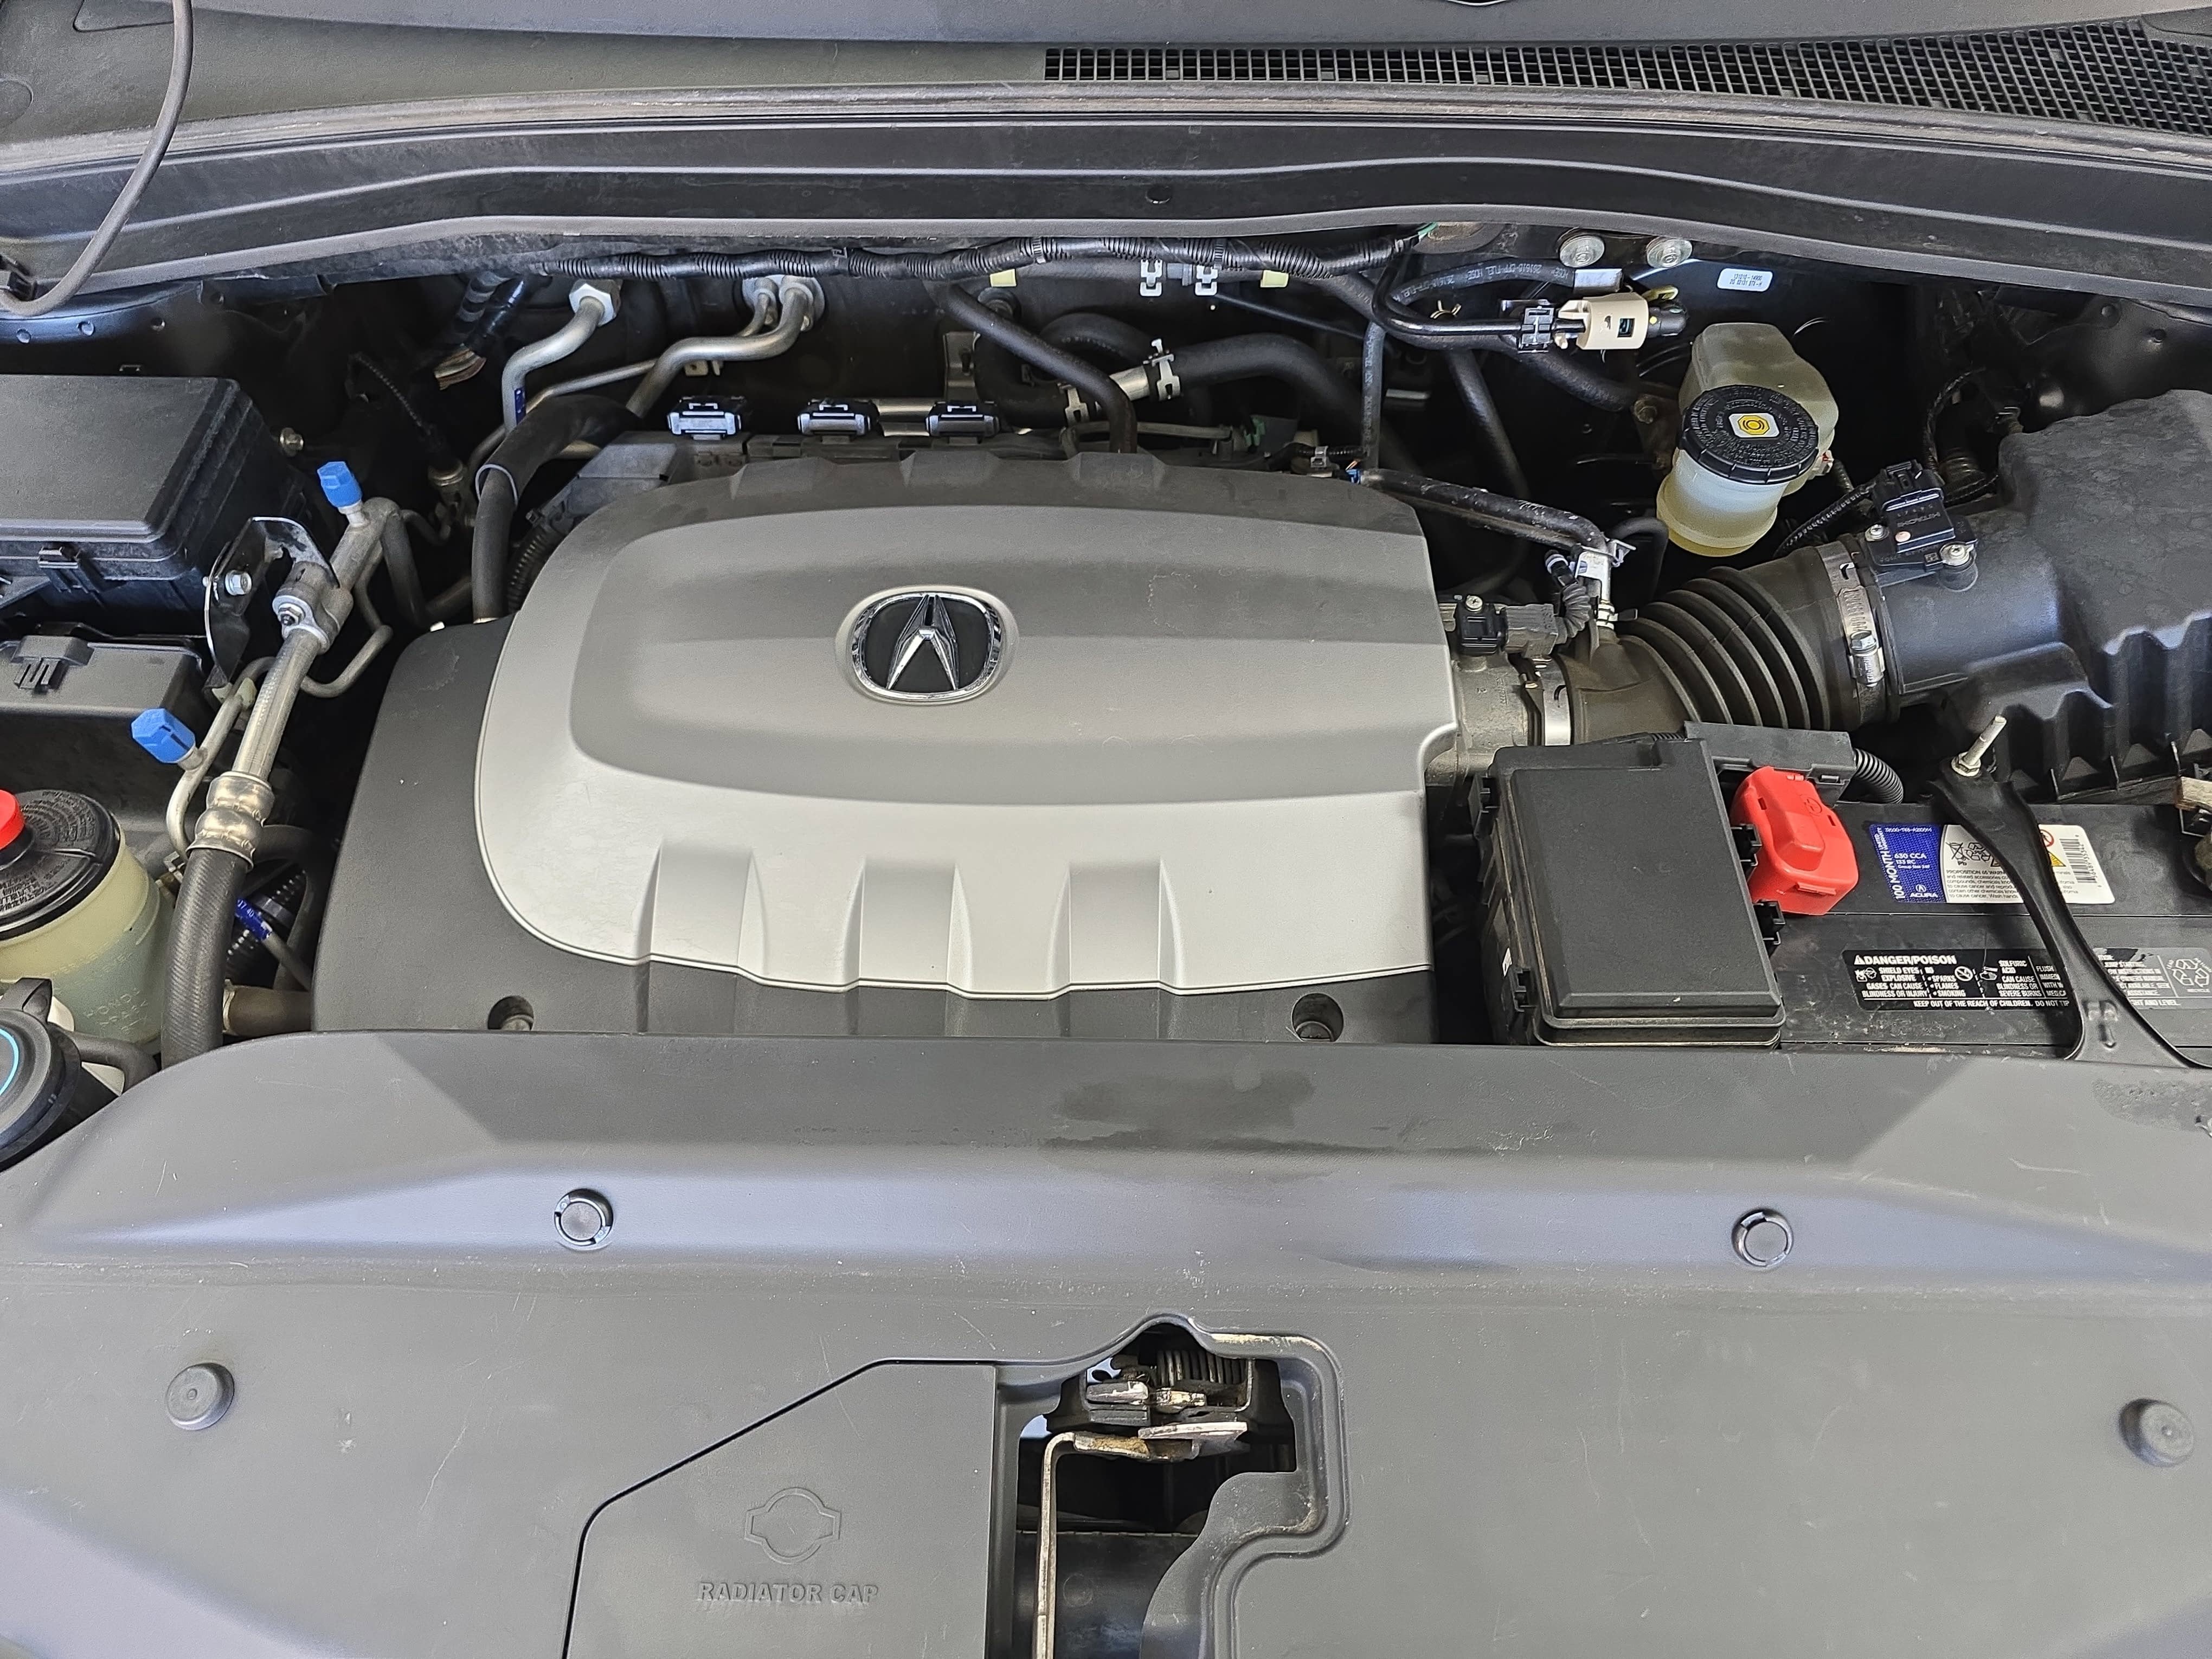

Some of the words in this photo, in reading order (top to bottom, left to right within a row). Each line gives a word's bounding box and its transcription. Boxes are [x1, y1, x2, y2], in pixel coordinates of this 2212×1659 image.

[1880, 851, 1901, 884] MONTH
[1892, 885, 1906, 900] 100
[1863, 955, 1957, 965] DANGER/POISON
[698, 1581, 822, 1603] RADIATOR
[830, 1583, 879, 1604] CAP
